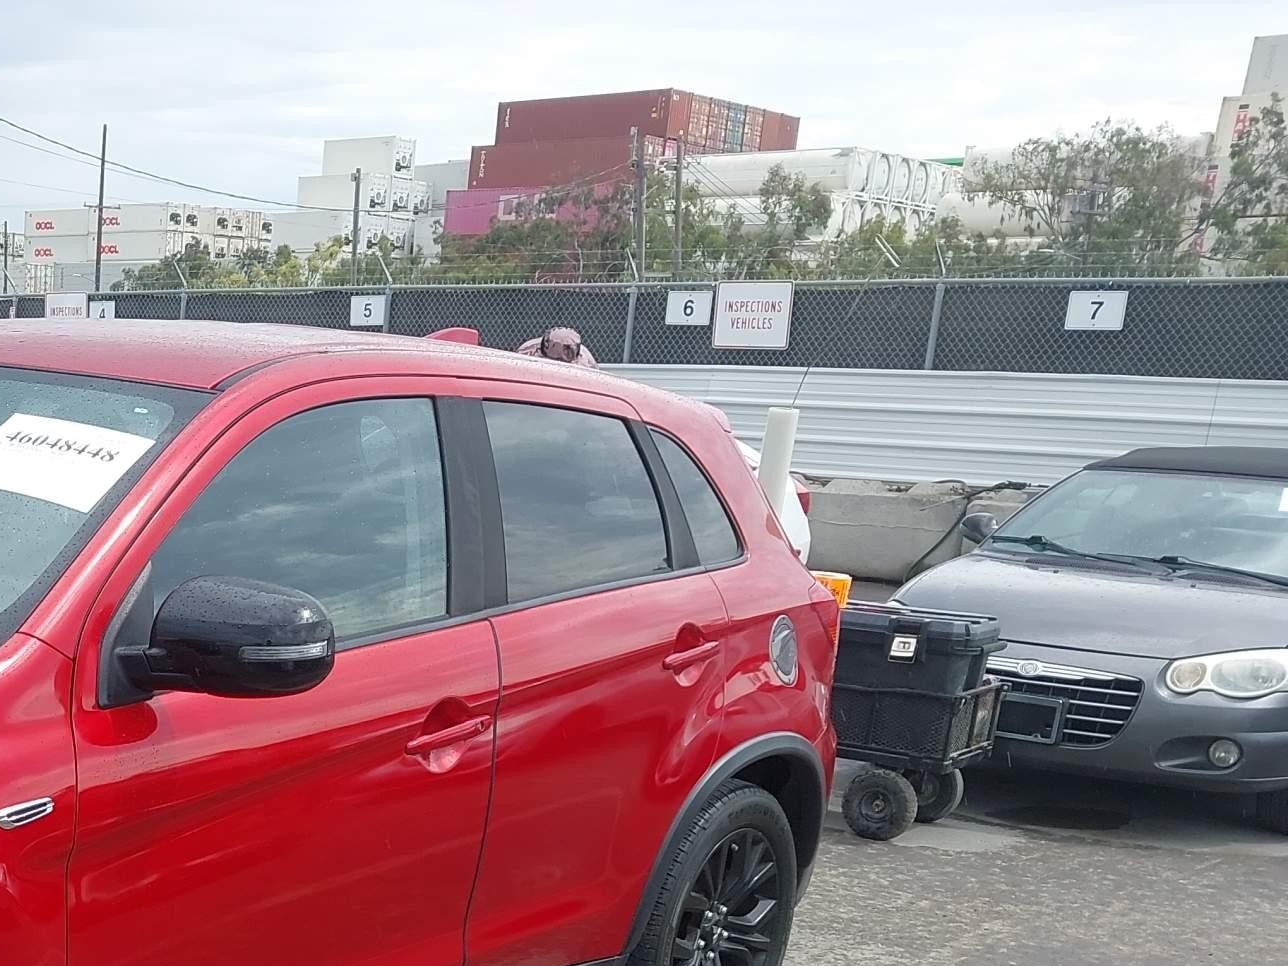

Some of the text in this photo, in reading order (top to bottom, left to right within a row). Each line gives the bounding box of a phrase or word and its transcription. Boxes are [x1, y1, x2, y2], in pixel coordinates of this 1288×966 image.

[35, 221, 55, 230] OOCL
[34, 248, 54, 257] OOCL
[50, 306, 83, 317] INSPECTIONS
[363, 303, 373, 318] 5
[683, 299, 695, 317] 6
[723, 300, 783, 313] INSPECTIONS
[1091, 301, 1105, 320] 7
[730, 317, 773, 330] VEHICLES
[5, 431, 120, 462] 46048448
